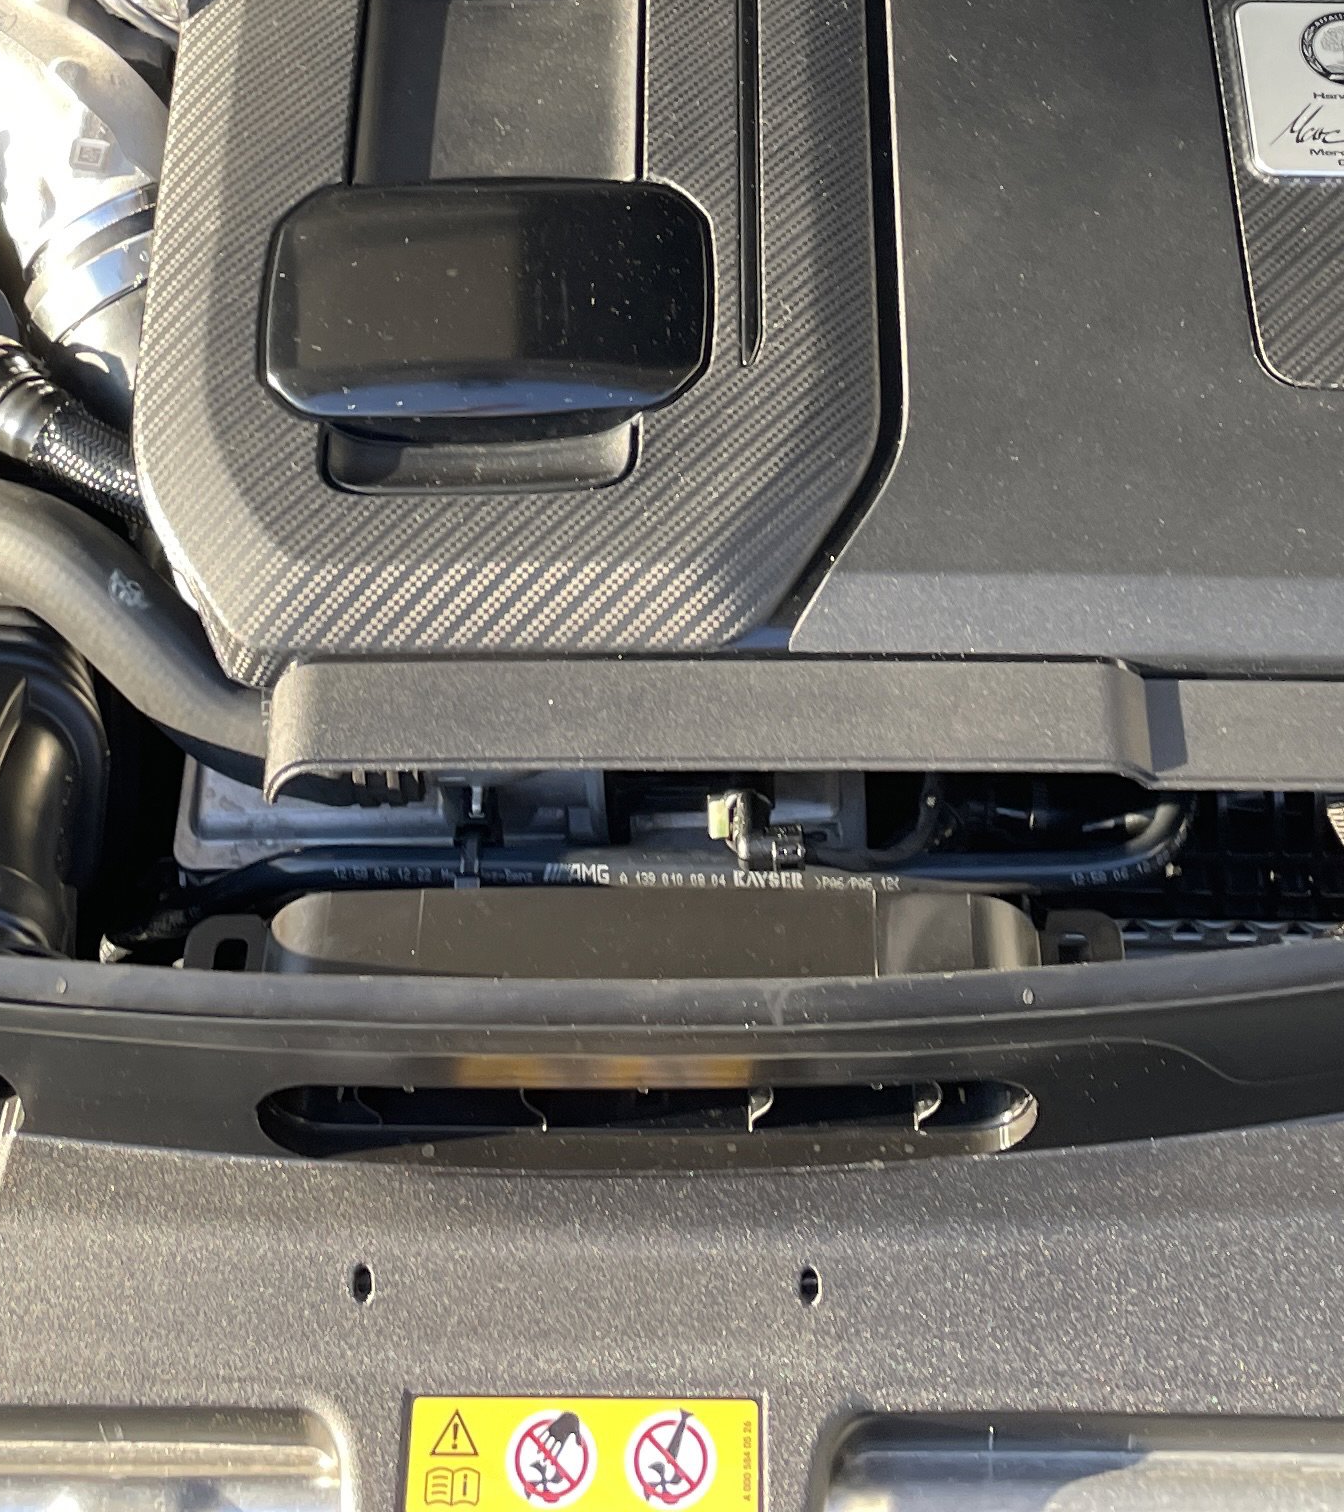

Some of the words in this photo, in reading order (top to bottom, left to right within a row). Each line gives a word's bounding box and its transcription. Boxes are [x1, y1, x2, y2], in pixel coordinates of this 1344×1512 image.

[619, 871, 629, 886] A
[635, 871, 656, 886] 139
[661, 872, 683, 887] 010
[711, 873, 726, 887] 04
[733, 869, 805, 888] KAYSER
